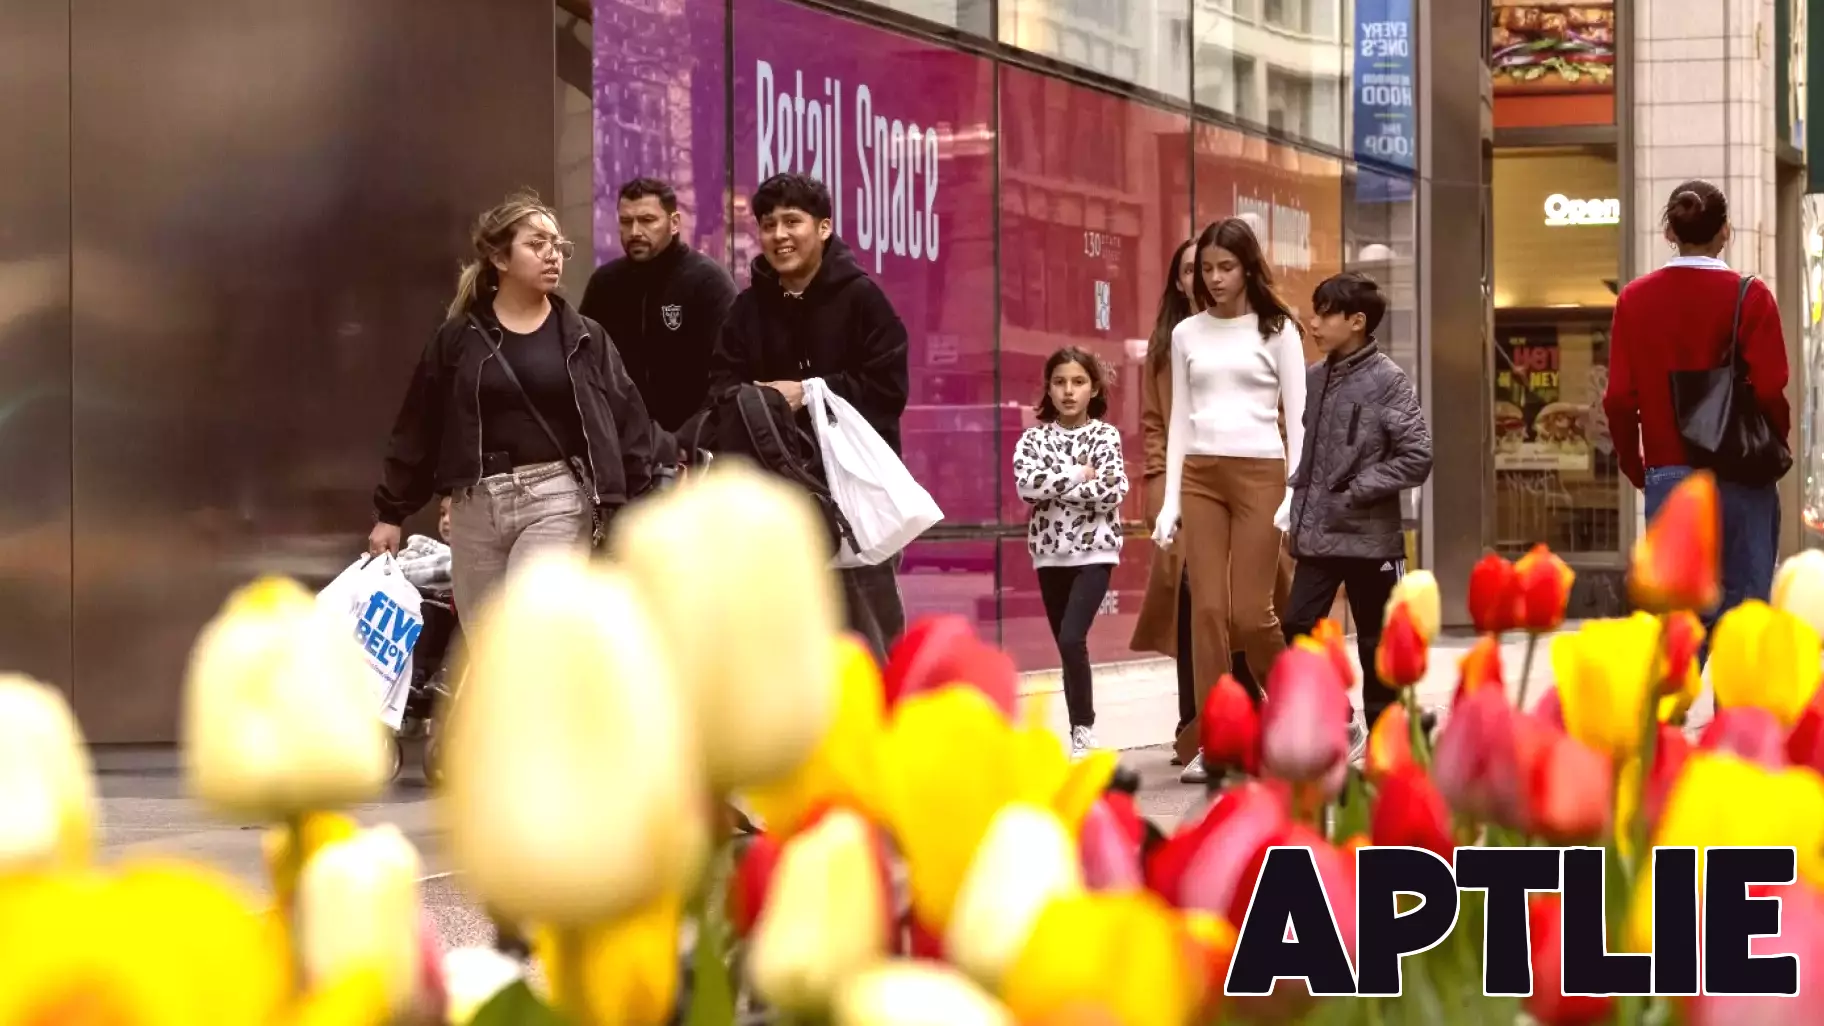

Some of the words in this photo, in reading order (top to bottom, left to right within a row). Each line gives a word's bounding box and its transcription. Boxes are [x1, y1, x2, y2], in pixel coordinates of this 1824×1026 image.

[757, 59, 842, 238] Retail
[856, 84, 940, 274] Space
[1544, 193, 1620, 226] Open
[1083, 231, 1101, 258] 130
